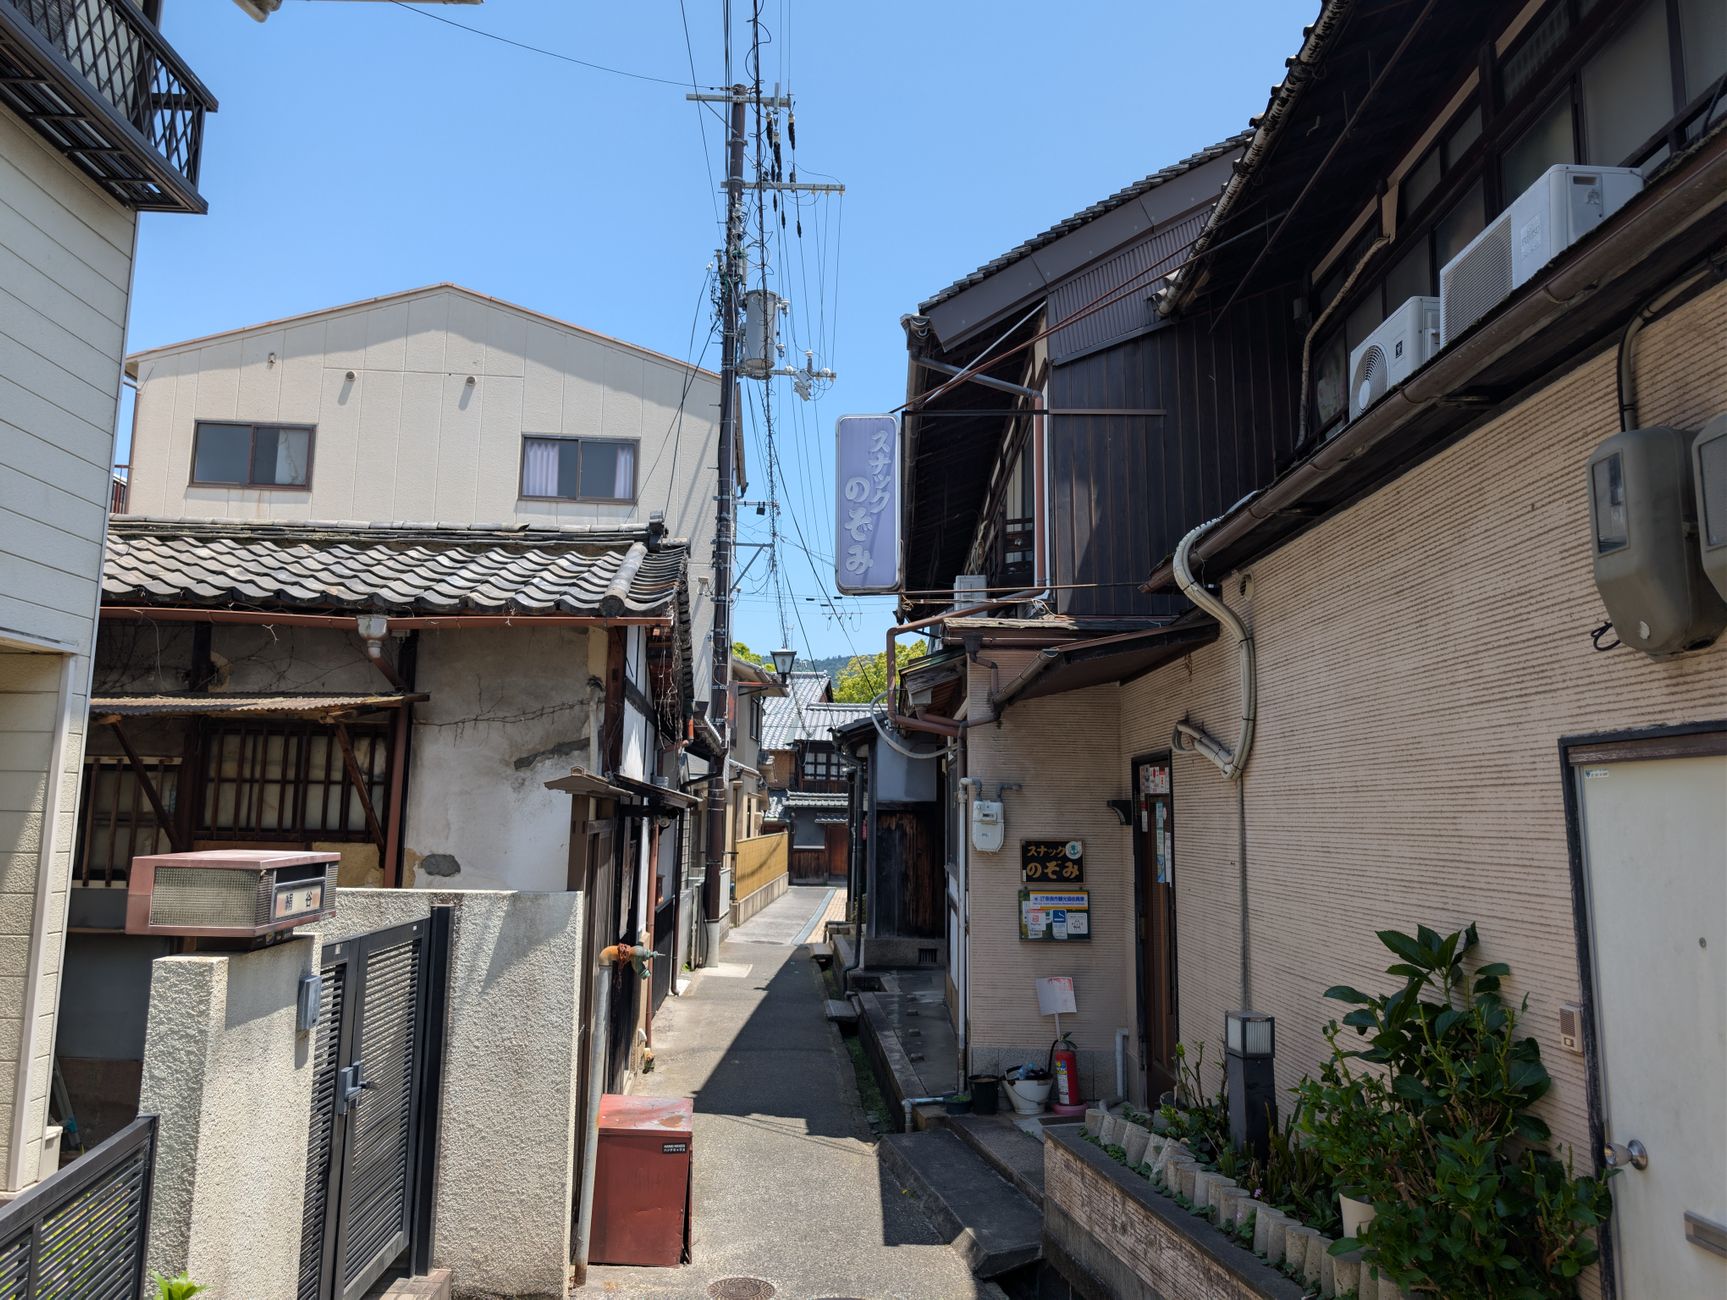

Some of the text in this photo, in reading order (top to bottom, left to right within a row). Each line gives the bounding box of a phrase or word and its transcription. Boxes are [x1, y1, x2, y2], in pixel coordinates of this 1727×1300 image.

[869, 430, 892, 514] スナック
[844, 476, 873, 575] のぞみ
[1026, 861, 1079, 879] のぞみ
[1027, 845, 1066, 858] スナック
